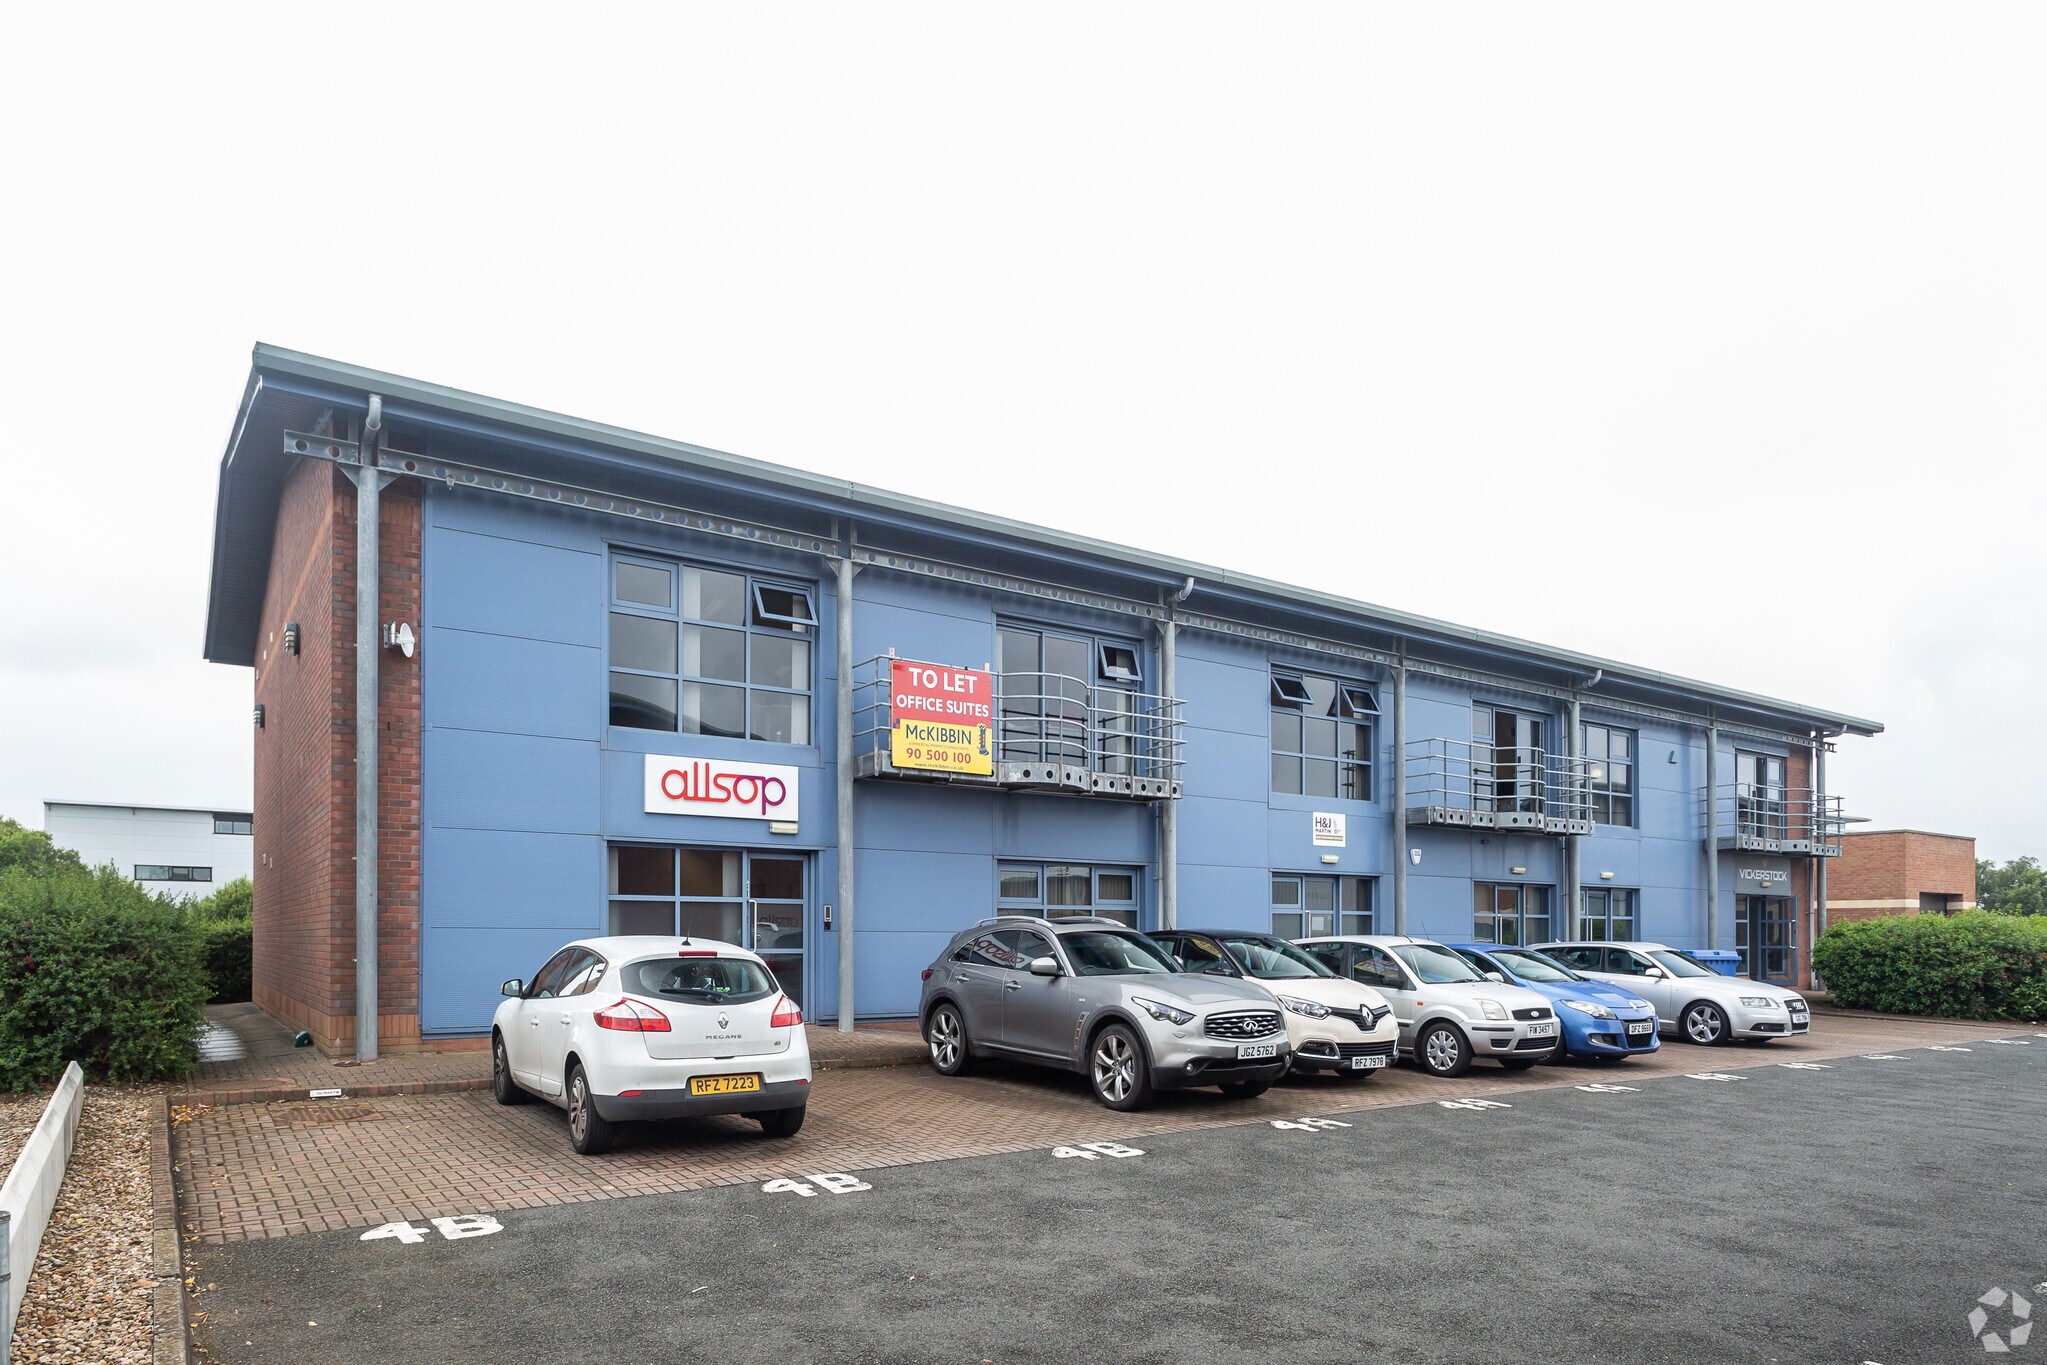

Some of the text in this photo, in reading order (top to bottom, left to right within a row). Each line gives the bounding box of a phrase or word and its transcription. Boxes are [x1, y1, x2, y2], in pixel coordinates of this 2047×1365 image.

[908, 667, 978, 694] TO LET
[896, 694, 989, 718] OFFICE SUITES
[905, 723, 972, 745] McKIBBIN
[906, 747, 971, 764] 90 500 100
[661, 761, 786, 816] allsop
[1315, 817, 1332, 828] H&J
[1739, 868, 1788, 882] VICKERSTOCK
[1241, 1045, 1274, 1057] JGZ 5762
[1355, 1057, 1383, 1067] RFZ 7978
[696, 1077, 754, 1092] RFZ 7223
[1051, 1142, 1147, 1161] 4B
[761, 1173, 873, 1197] 4B
[359, 1213, 505, 1244] 4B
